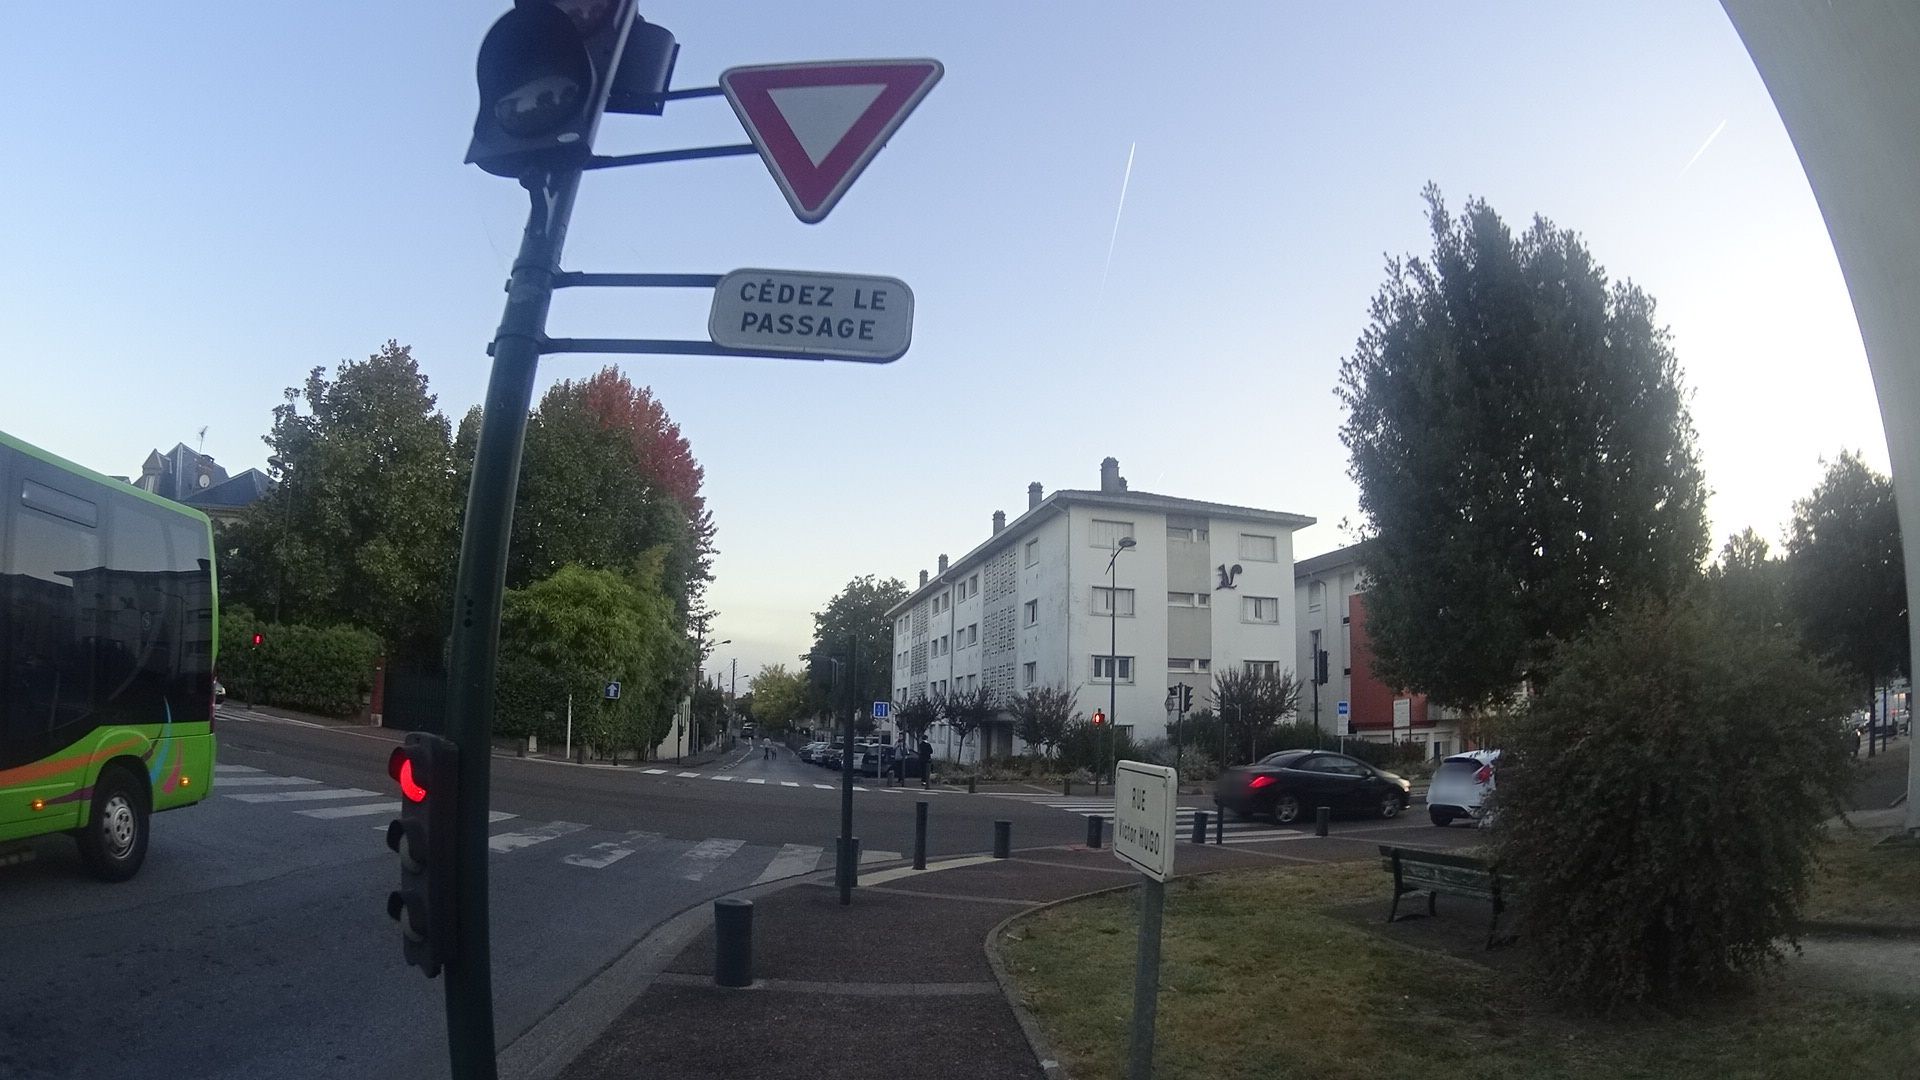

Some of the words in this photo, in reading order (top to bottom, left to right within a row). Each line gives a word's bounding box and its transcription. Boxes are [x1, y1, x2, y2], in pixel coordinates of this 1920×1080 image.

[740, 279, 834, 307] CÉDEZ
[853, 288, 887, 311] LE
[740, 311, 876, 341] PASSAGE
[1132, 787, 1145, 811] RUE
[1139, 826, 1160, 855] HUGO
